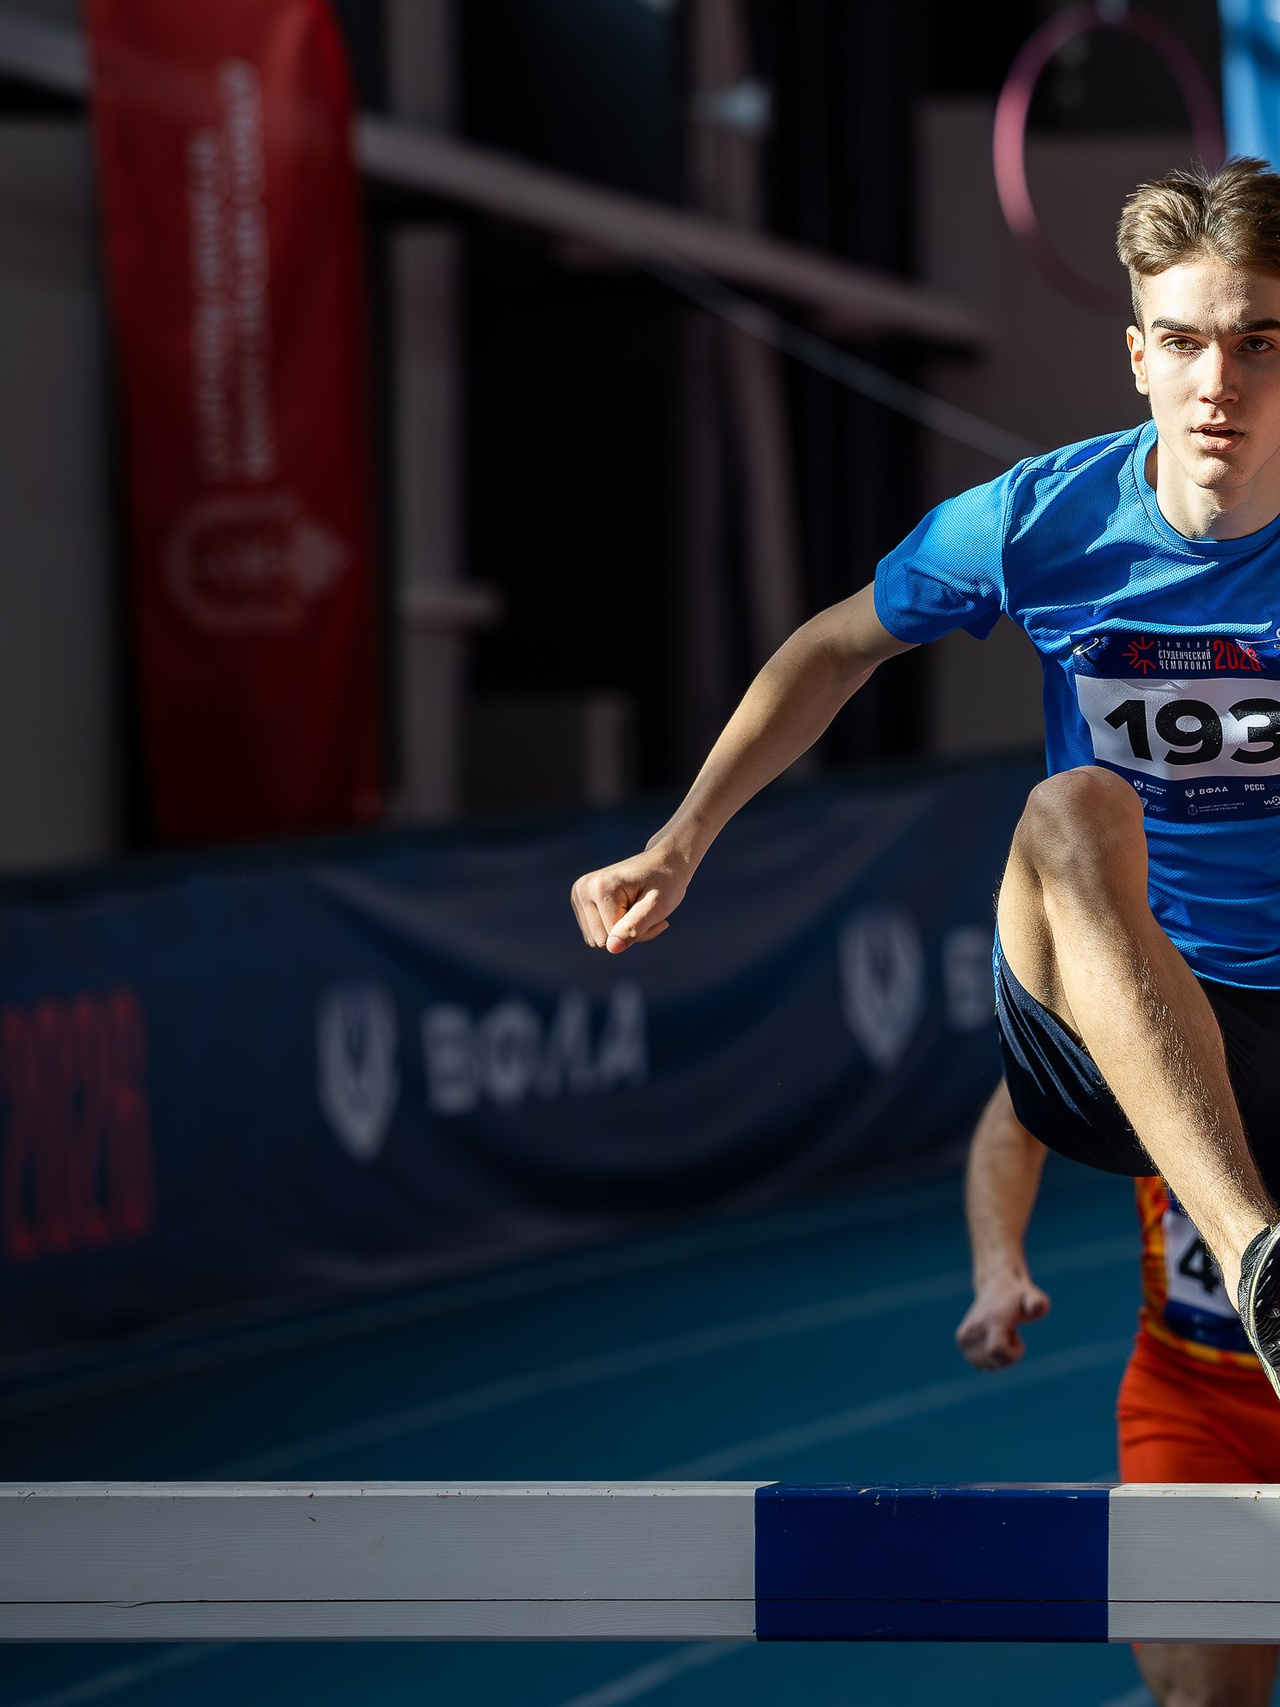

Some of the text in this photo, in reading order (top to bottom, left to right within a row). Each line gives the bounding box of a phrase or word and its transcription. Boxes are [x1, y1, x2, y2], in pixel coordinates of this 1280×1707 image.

[1158, 649, 1212, 661] СТУДЕНЧЕСКИЙ
[1159, 660, 1212, 670] ЧЕМПИОНАТ
[1199, 786, 1229, 795] ВФЛА
[1244, 783, 1265, 791] РССС
